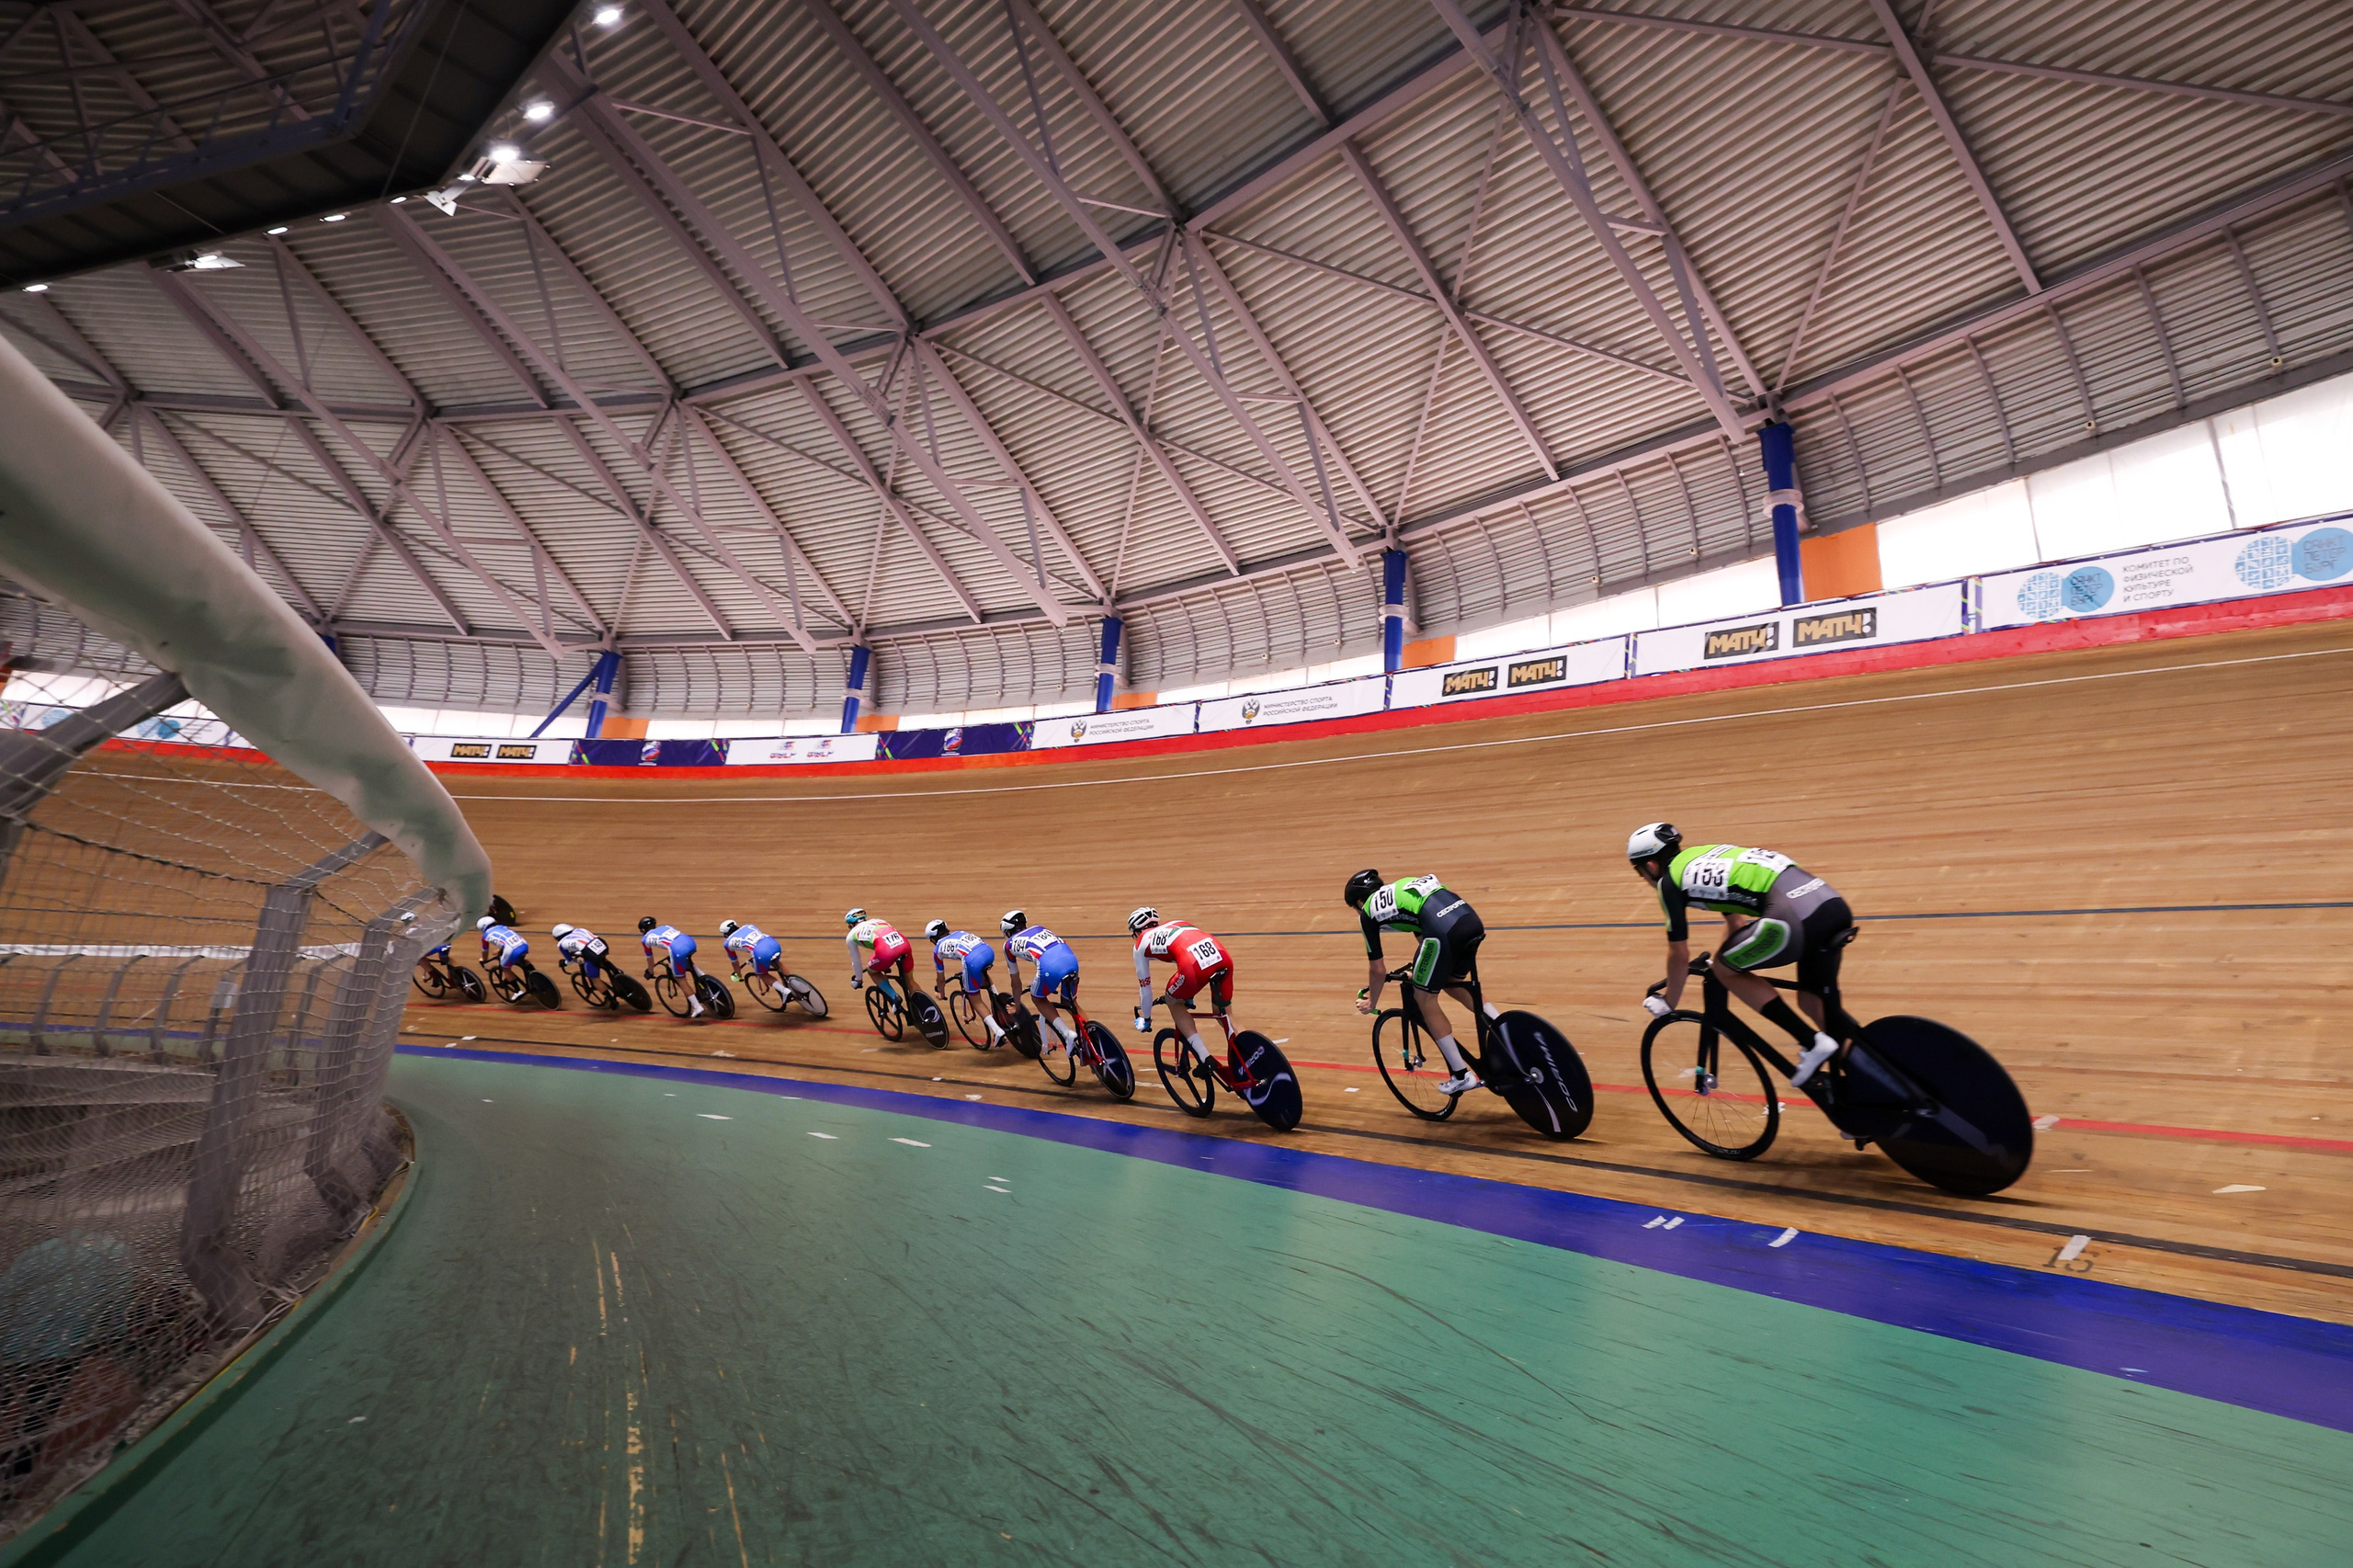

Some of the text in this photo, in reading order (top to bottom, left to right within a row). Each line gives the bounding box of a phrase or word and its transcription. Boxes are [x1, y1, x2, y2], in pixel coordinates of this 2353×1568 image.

[2122, 556, 2189, 573] КОМИТЕТ ПО
[2123, 565, 2194, 583] ФИЗИЧЕСКОЙ
[2123, 579, 2171, 593] КУЛЬТУРЕ
[2132, 589, 2175, 602] СПОРТУ
[1798, 613, 1871, 642] МАТЧ!
[1708, 627, 1774, 654] МАТЧ!
[1510, 660, 1563, 684] МАТЧ!
[1445, 670, 1495, 692] МАТЧ!
[1310, 696, 1333, 704] СПОРТА
[1374, 888, 1393, 912] 150
[886, 932, 900, 944] 176
[1013, 939, 1026, 952] 184
[1152, 931, 1168, 946] 168
[1193, 941, 1216, 960] 168
